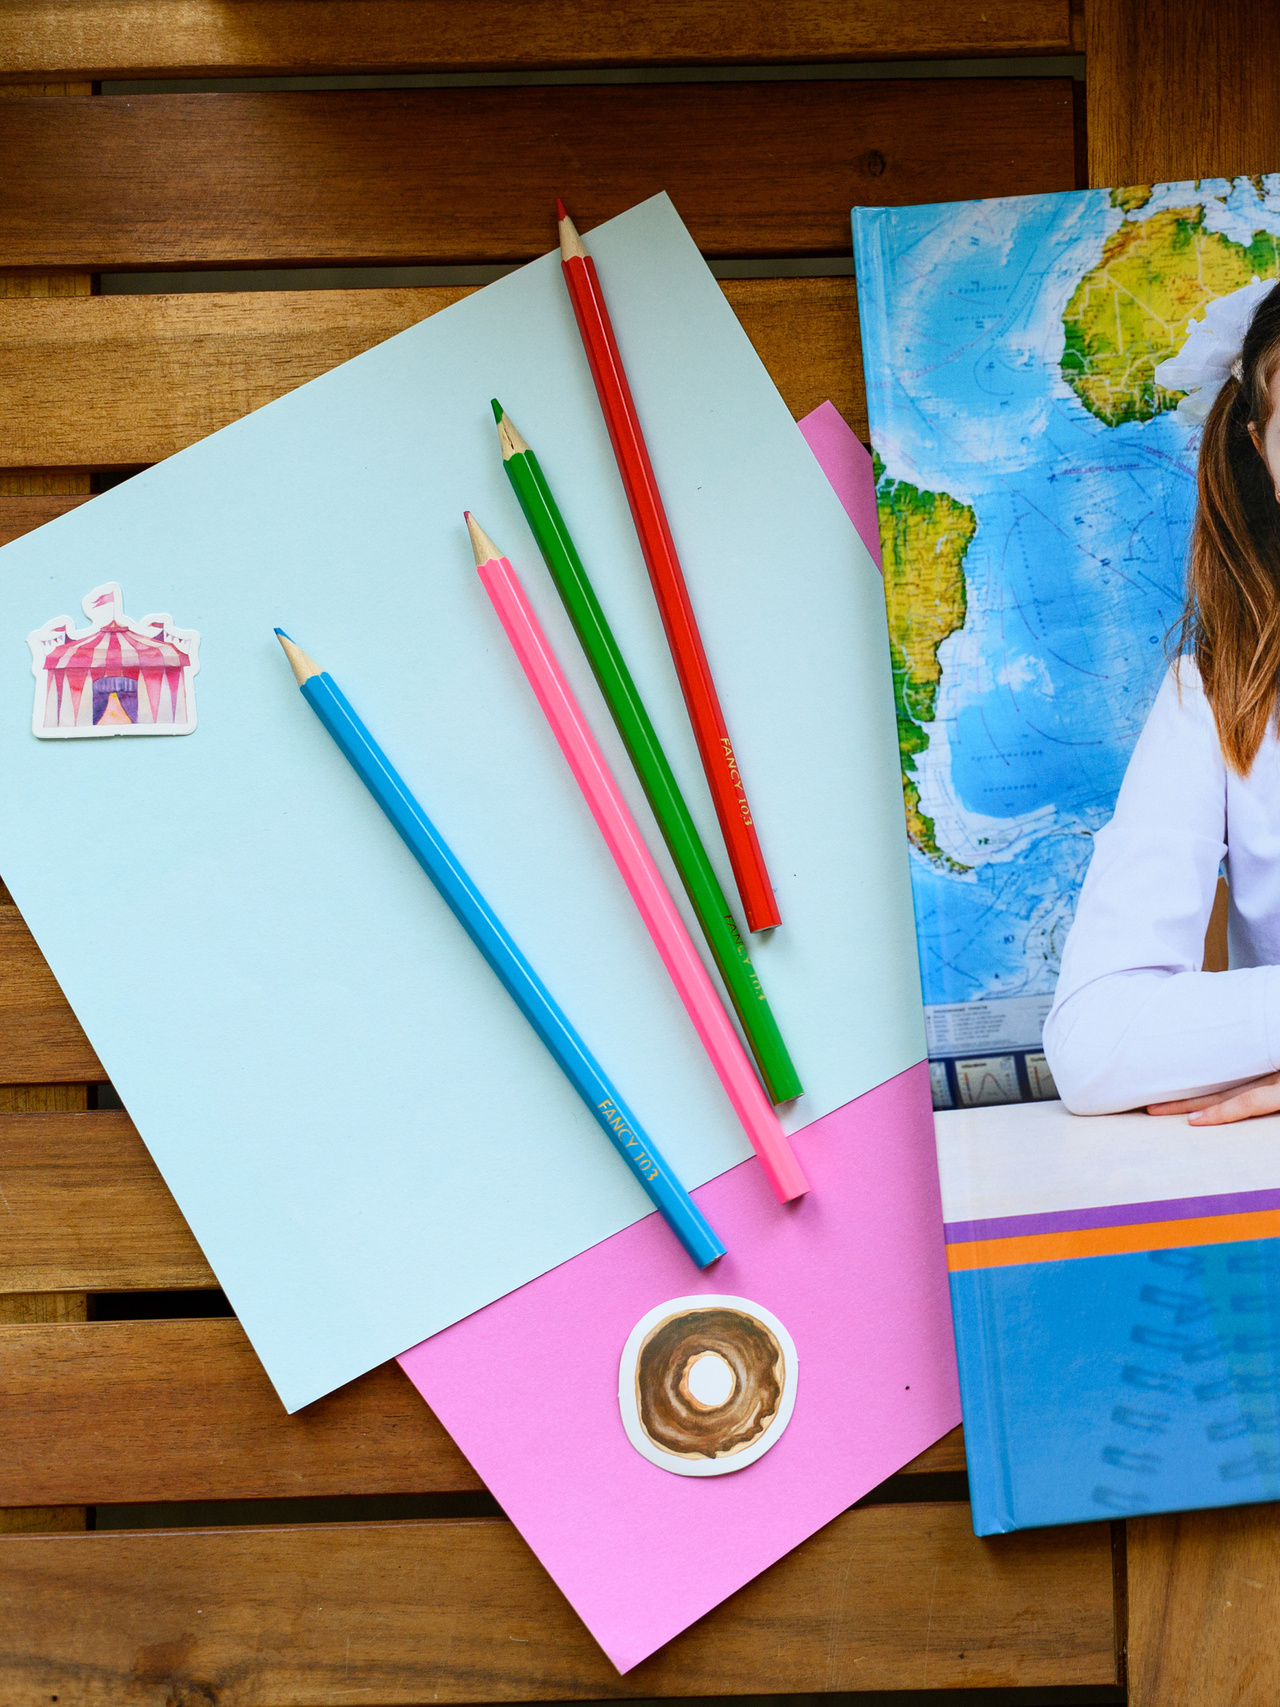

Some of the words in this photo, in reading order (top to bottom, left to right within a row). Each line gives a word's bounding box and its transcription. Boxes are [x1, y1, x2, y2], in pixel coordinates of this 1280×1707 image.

[720, 737, 743, 790] FANCY
[738, 798, 753, 826] 103
[723, 914, 752, 965] FANCY
[597, 1098, 639, 1148] FANCY
[633, 1151, 659, 1181] 103
